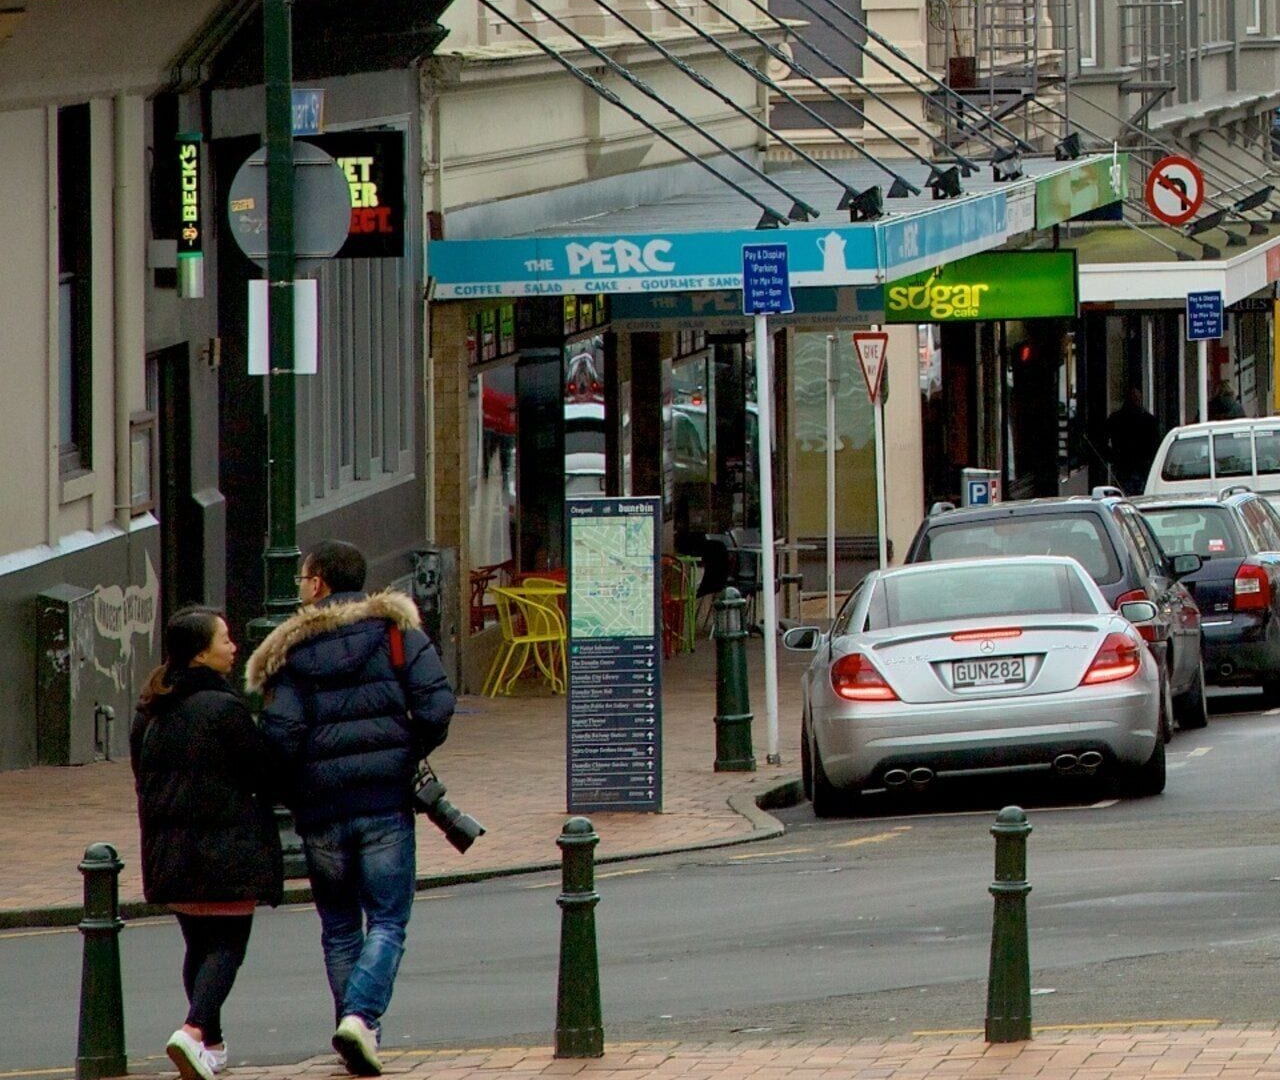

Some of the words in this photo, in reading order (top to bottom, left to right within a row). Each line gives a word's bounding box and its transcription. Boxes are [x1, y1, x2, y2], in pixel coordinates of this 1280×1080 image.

[182, 143, 198, 222] BECK'S
[523, 259, 555, 273] THE
[565, 239, 676, 276] PERC
[745, 250, 756, 262] Pay
[762, 249, 785, 261] Display
[753, 264, 778, 274] Parking
[454, 285, 502, 296] COFFEE
[524, 283, 562, 293] SALAD
[585, 281, 619, 292] CAKE
[641, 278, 703, 290] GOURMET
[708, 275, 741, 288] SAND
[888, 283, 989, 319] sugar
[863, 345, 879, 359] GIVE
[972, 484, 989, 503] P
[956, 660, 1022, 681] GUN282
